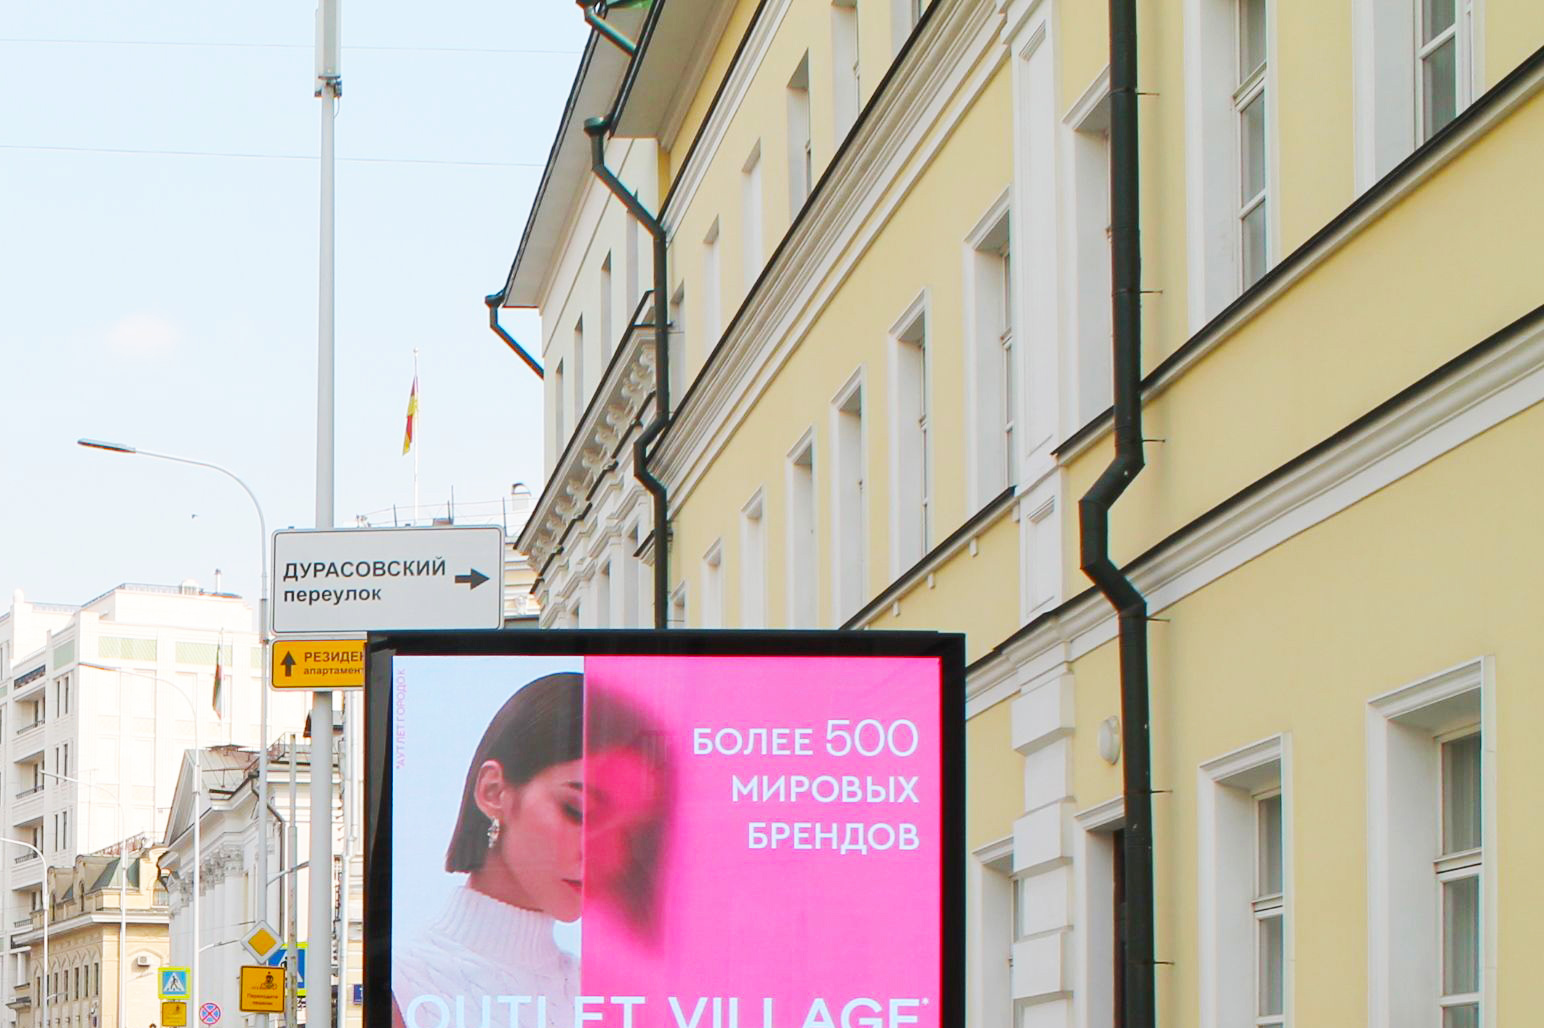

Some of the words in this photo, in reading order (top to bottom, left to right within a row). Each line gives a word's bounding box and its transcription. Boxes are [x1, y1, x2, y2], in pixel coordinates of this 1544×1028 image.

[283, 556, 446, 582] ДУРАСОВСКИЙ
[283, 588, 382, 605] переулок
[304, 667, 363, 676] апартамен
[692, 727, 814, 756] БОЛЕЕ
[825, 718, 920, 758] 500
[731, 774, 920, 803] МИРОВЫХ
[747, 821, 921, 855] БРЕНДОВ
